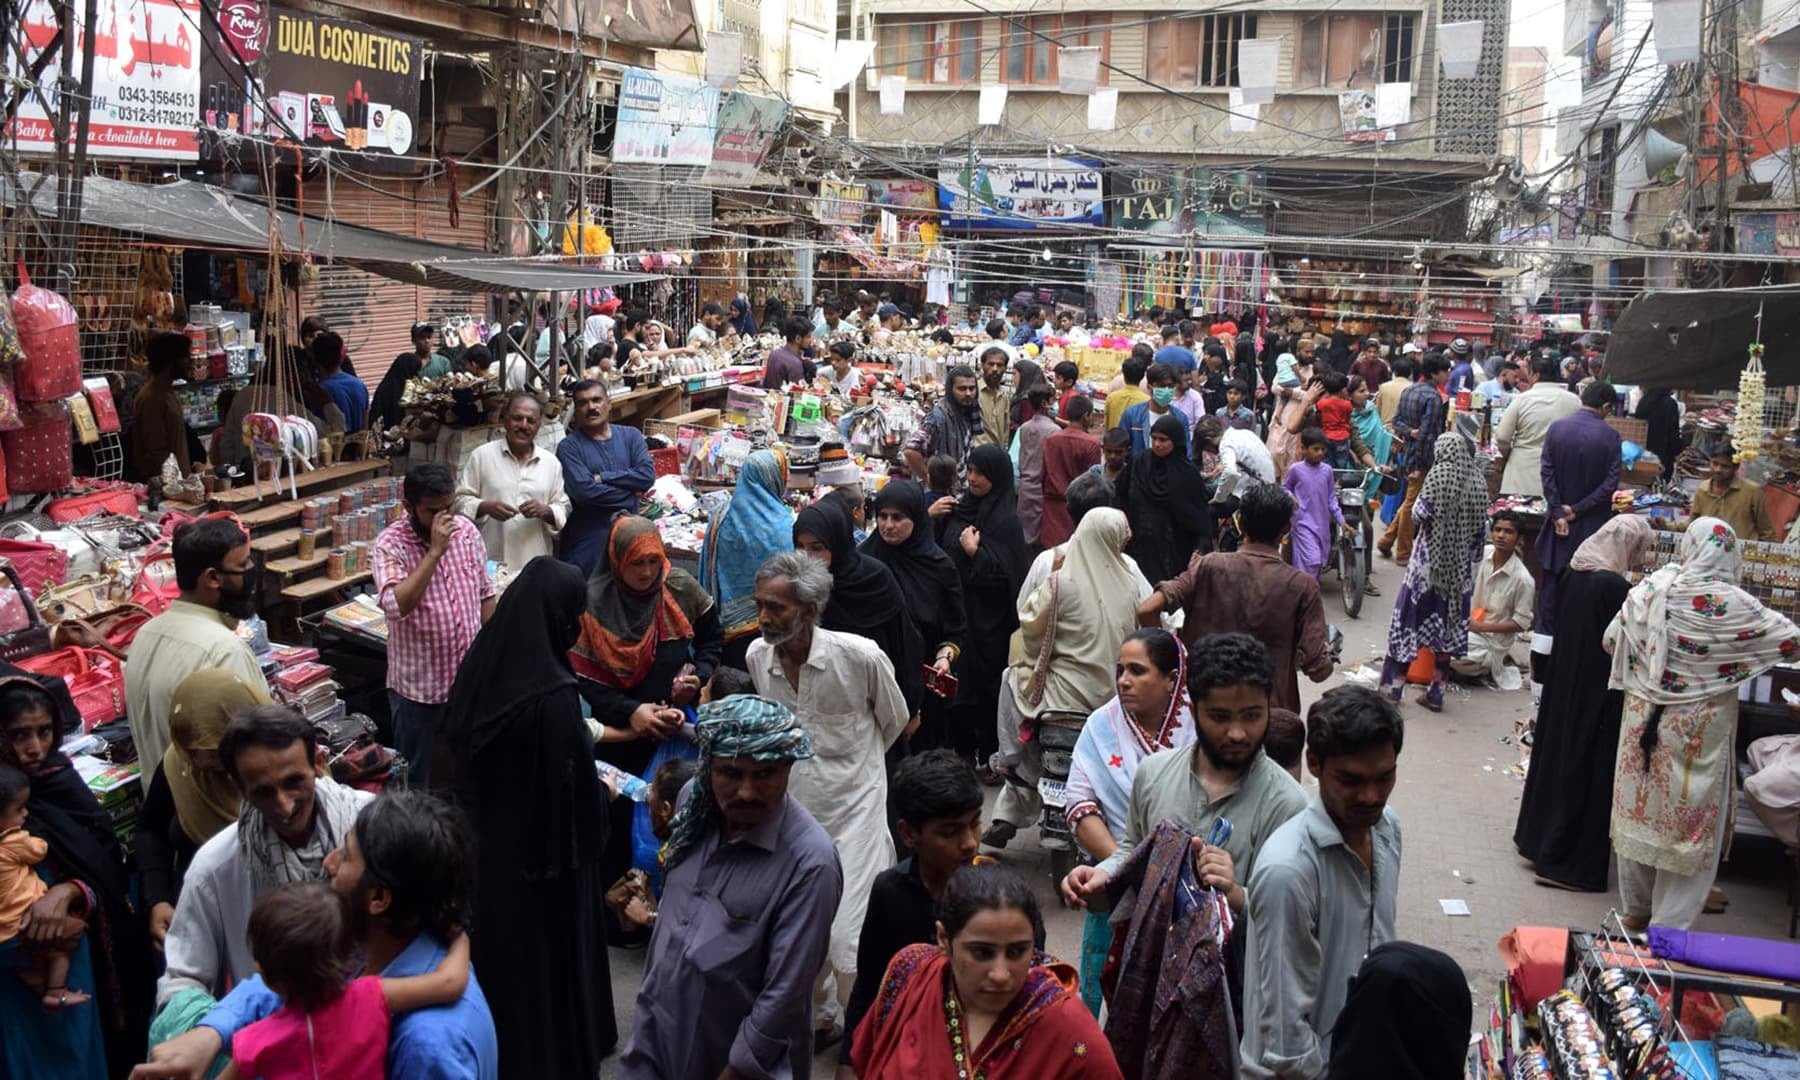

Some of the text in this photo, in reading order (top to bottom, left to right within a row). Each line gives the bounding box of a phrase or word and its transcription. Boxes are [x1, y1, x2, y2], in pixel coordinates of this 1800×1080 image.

[278, 15, 411, 75] DUA COSMETICS
[118, 86, 196, 108] 0343-3564513
[98, 129, 153, 147] Available
[155, 133, 178, 147] here
[1116, 198, 1174, 221] TAJ
